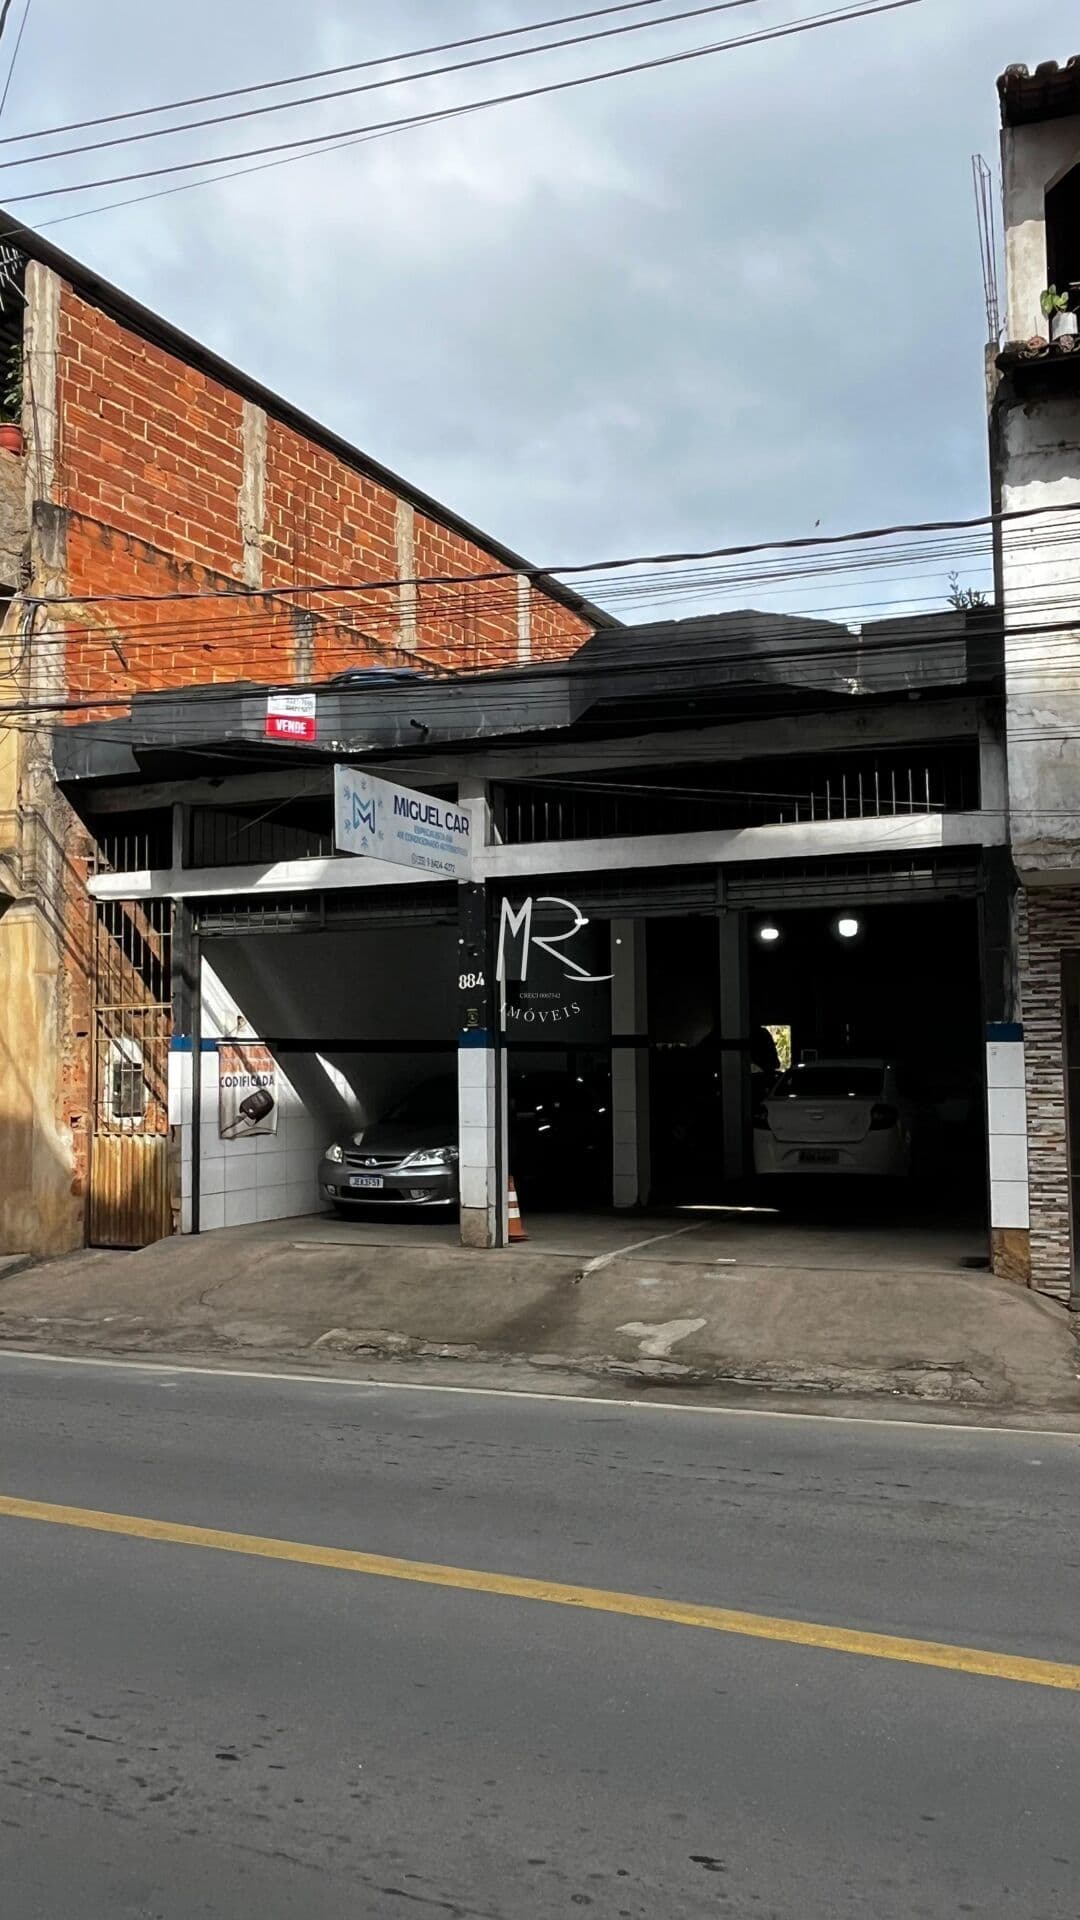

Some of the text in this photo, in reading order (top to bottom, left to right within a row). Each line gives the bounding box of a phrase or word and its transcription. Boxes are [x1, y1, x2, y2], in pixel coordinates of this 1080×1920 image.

[276, 719, 307, 735] VENDE
[394, 795, 470, 837] MIGUEL CAR
[458, 971, 485, 990] 884
[220, 1074, 275, 1088] CODIFICADA
